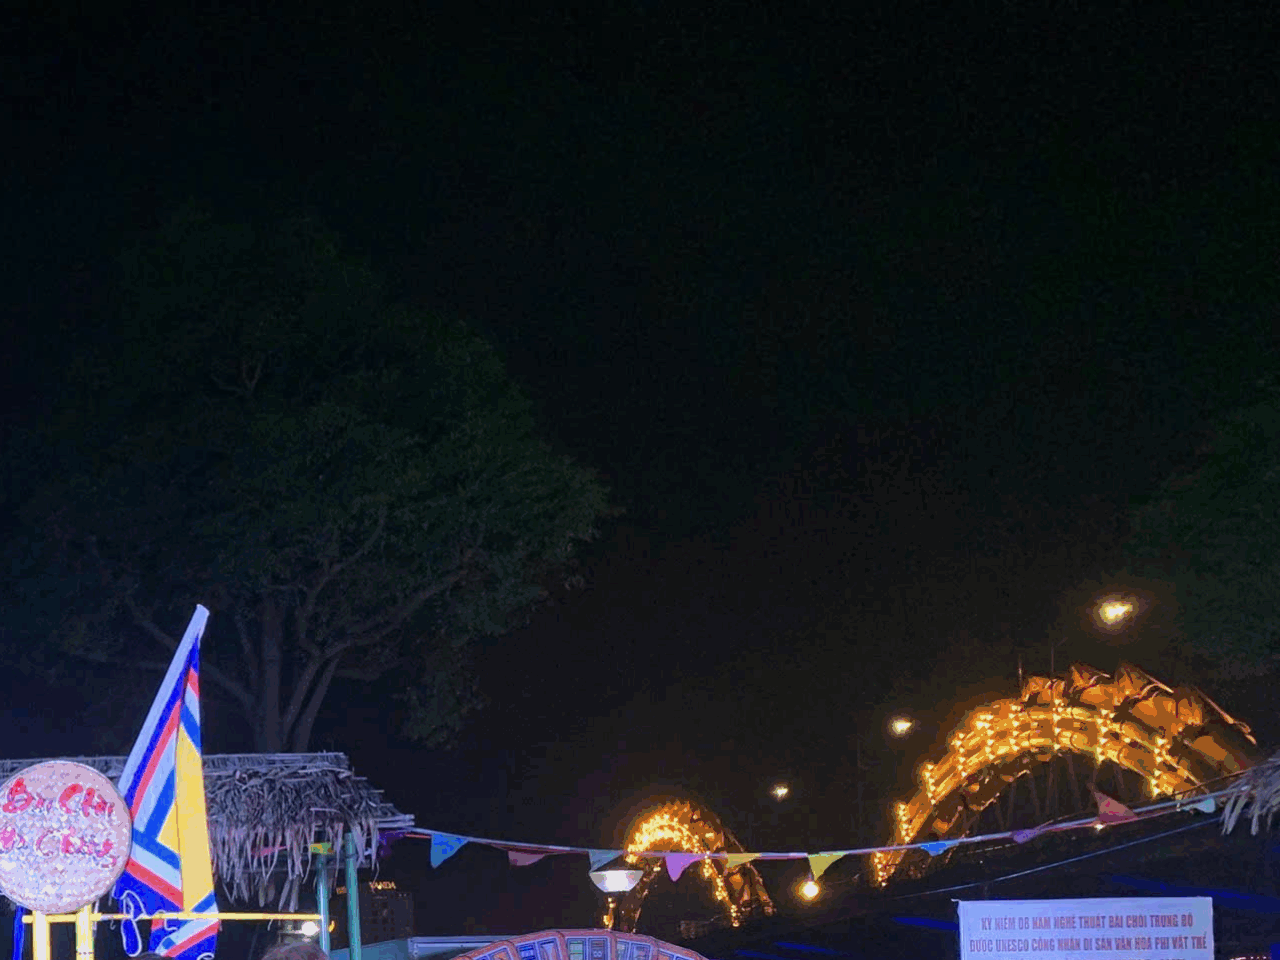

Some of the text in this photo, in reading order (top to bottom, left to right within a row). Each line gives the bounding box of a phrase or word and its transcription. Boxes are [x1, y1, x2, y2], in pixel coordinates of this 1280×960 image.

[1149, 914, 1179, 928] TRUNG
[995, 939, 1029, 952] UNESCO
[1031, 936, 1055, 952] CÔNG
[1083, 937, 1093, 951] DI
[1154, 936, 1170, 950] PHI
